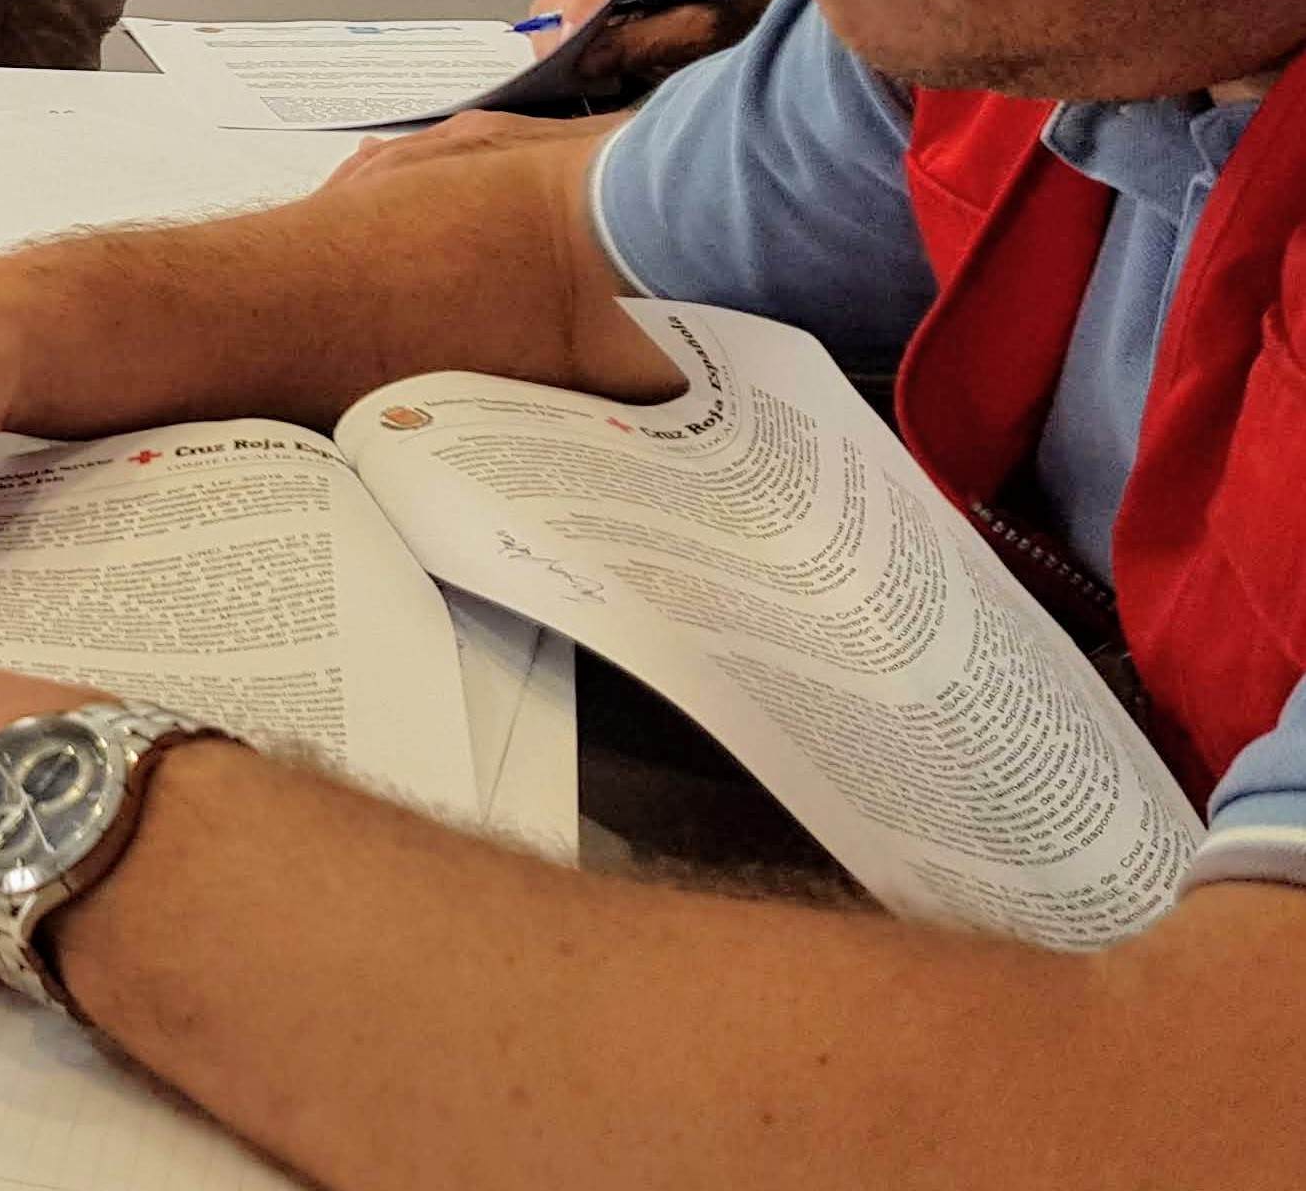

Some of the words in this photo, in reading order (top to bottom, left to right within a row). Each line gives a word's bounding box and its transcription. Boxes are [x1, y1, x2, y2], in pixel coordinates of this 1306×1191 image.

[668, 316, 724, 392] Española
[685, 399, 724, 436] Roja
[640, 426, 689, 440] Cruz
[175, 445, 225, 458] Cruz
[233, 439, 285, 452] Roja
